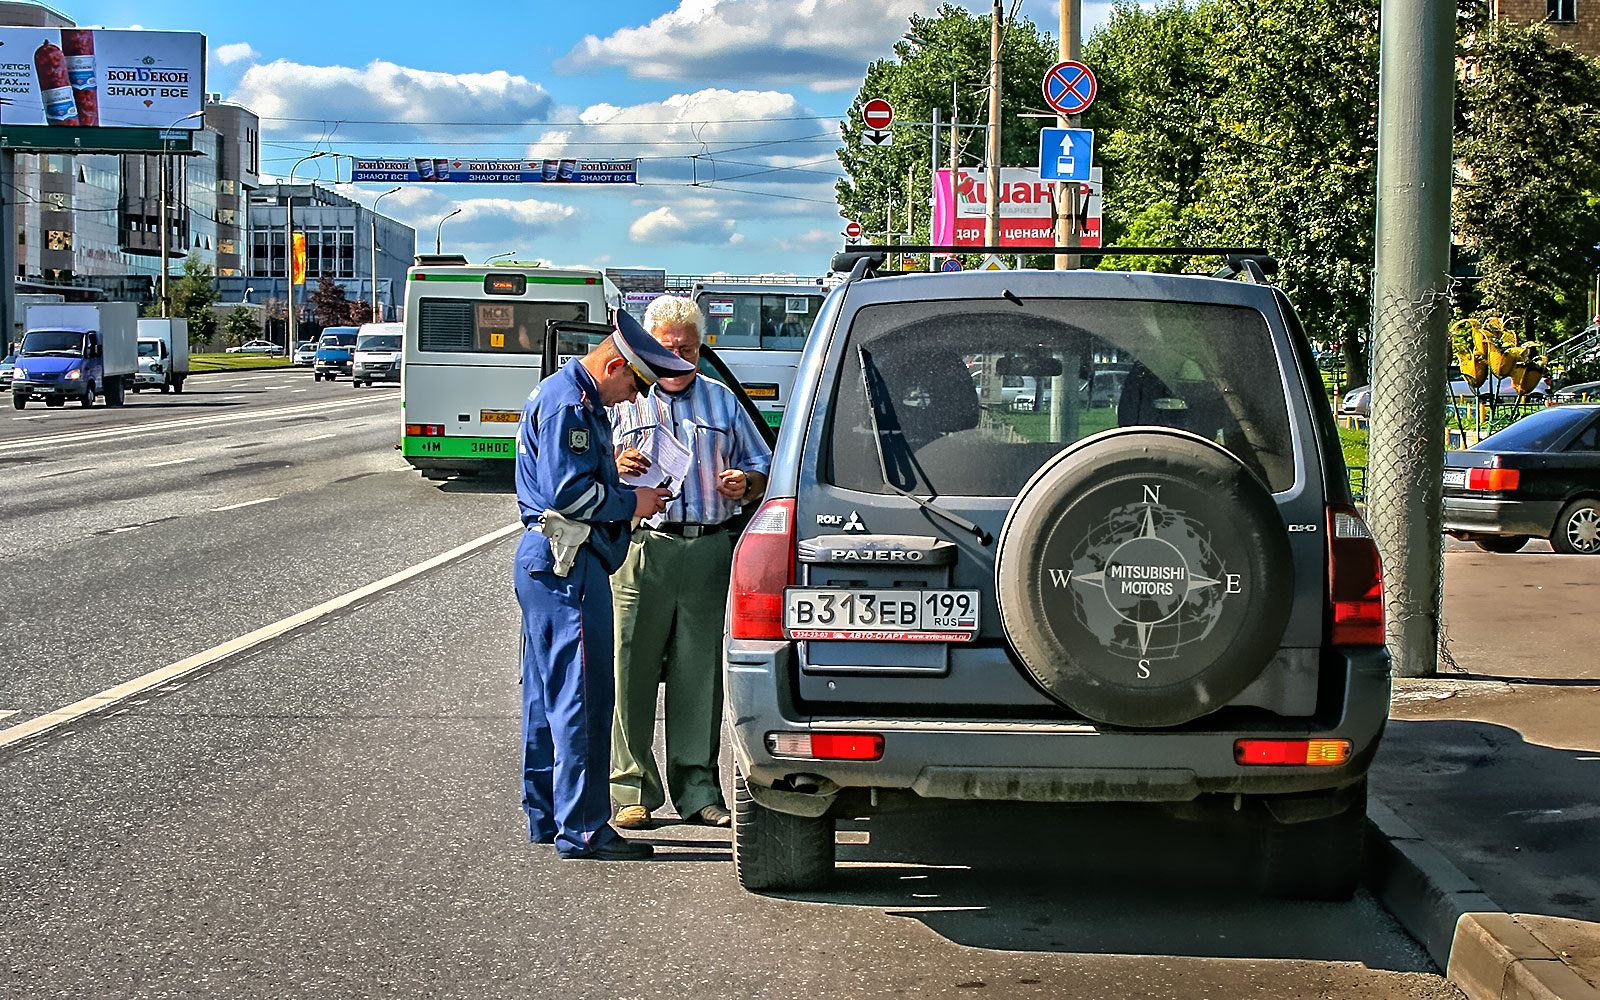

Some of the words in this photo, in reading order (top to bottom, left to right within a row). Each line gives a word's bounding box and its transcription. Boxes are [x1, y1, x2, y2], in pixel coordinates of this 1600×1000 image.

[107, 87, 156, 97] ЗНАЮТ
[160, 88, 189, 98] ВСЕ
[580, 174, 612, 182] ЗНАЮТ
[614, 174, 632, 182] ВСЕ
[471, 442, 509, 453] ЗАНОС
[1142, 485, 1161, 504] N
[816, 514, 843, 525] ROLF
[831, 550, 924, 561] PAJERO
[1049, 569, 1074, 588] W
[1111, 565, 1185, 580] MITSUBISHI
[1121, 581, 1174, 596] MOTORS
[1225, 574, 1241, 594] E
[796, 594, 917, 625] В313ЕВ
[925, 593, 971, 617] 199
[934, 617, 958, 627] RUS
[1136, 660, 1150, 679] S
